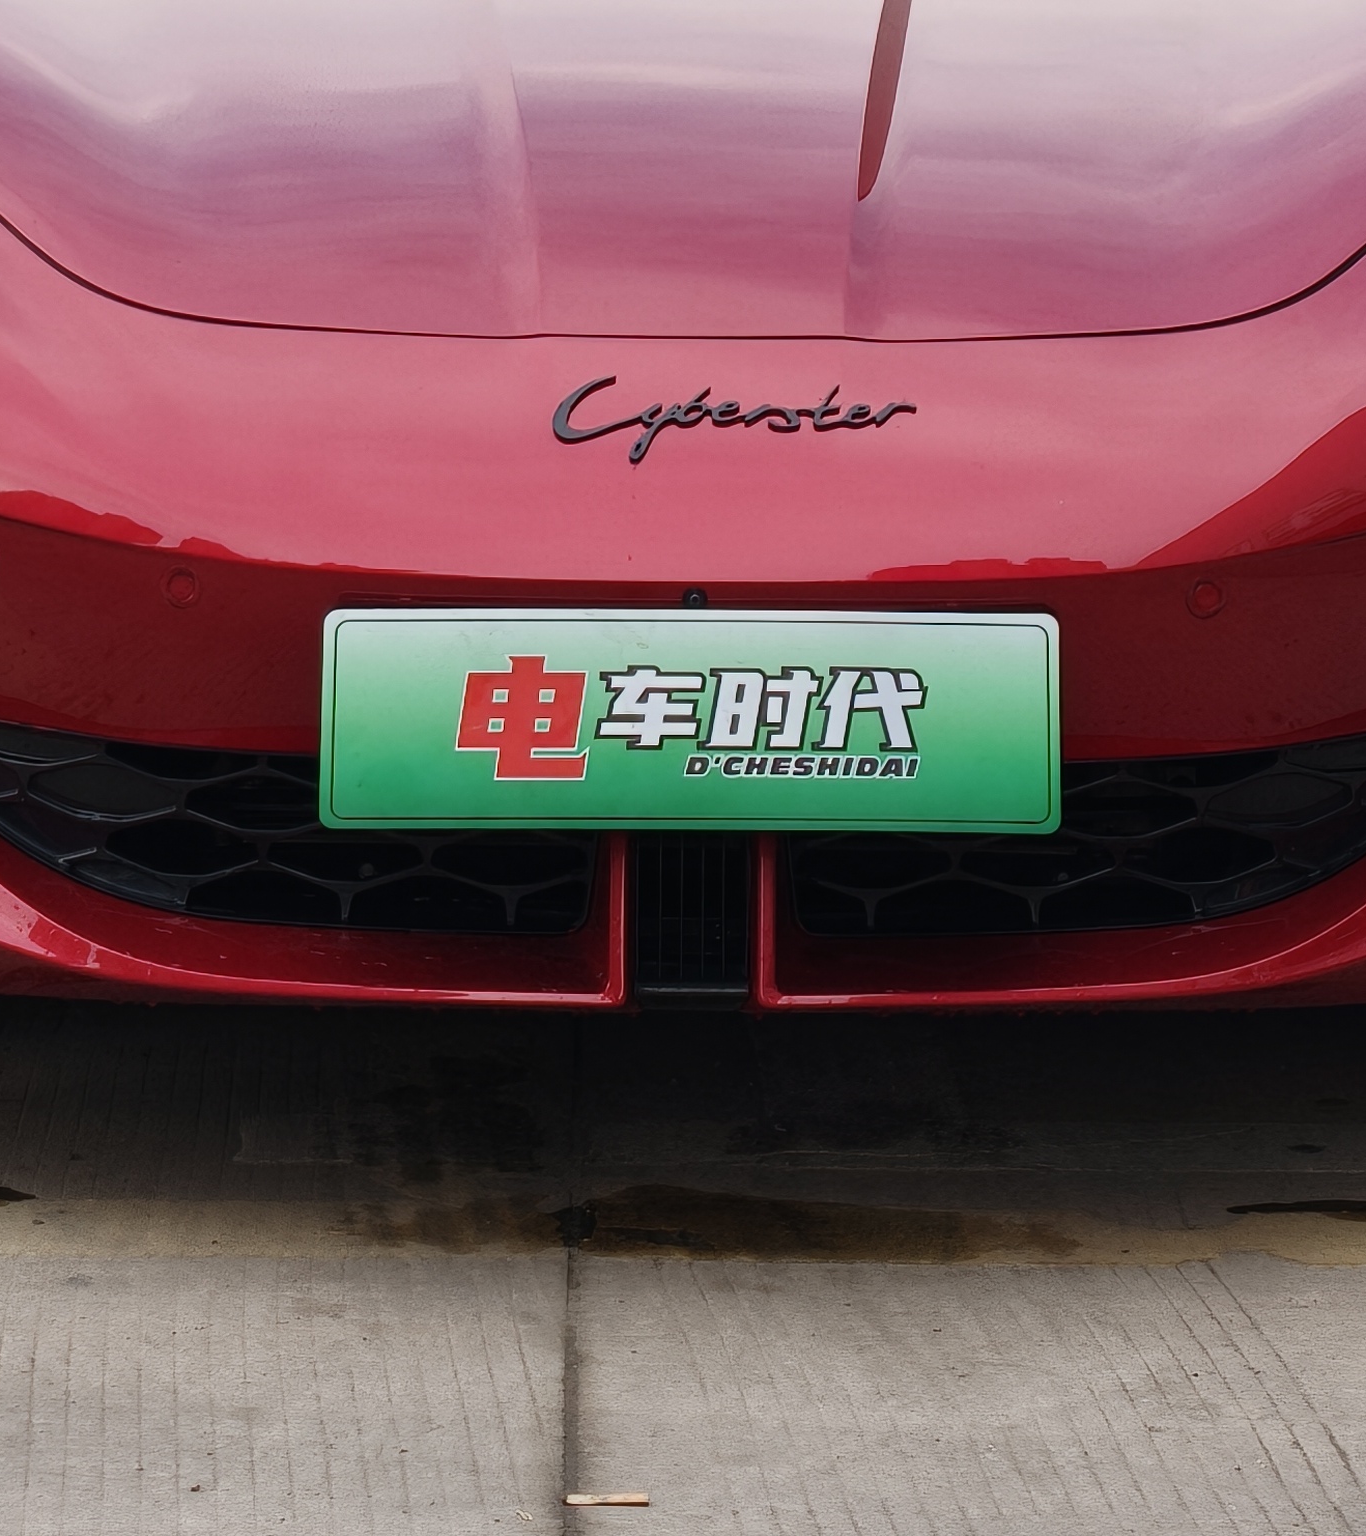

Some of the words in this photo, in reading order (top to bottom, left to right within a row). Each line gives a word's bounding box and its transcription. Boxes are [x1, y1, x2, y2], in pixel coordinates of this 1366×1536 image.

[552, 375, 917, 463] Cyberster
[456, 655, 928, 781] 电车时代
[683, 753, 920, 780] D'CHESHIDAI
